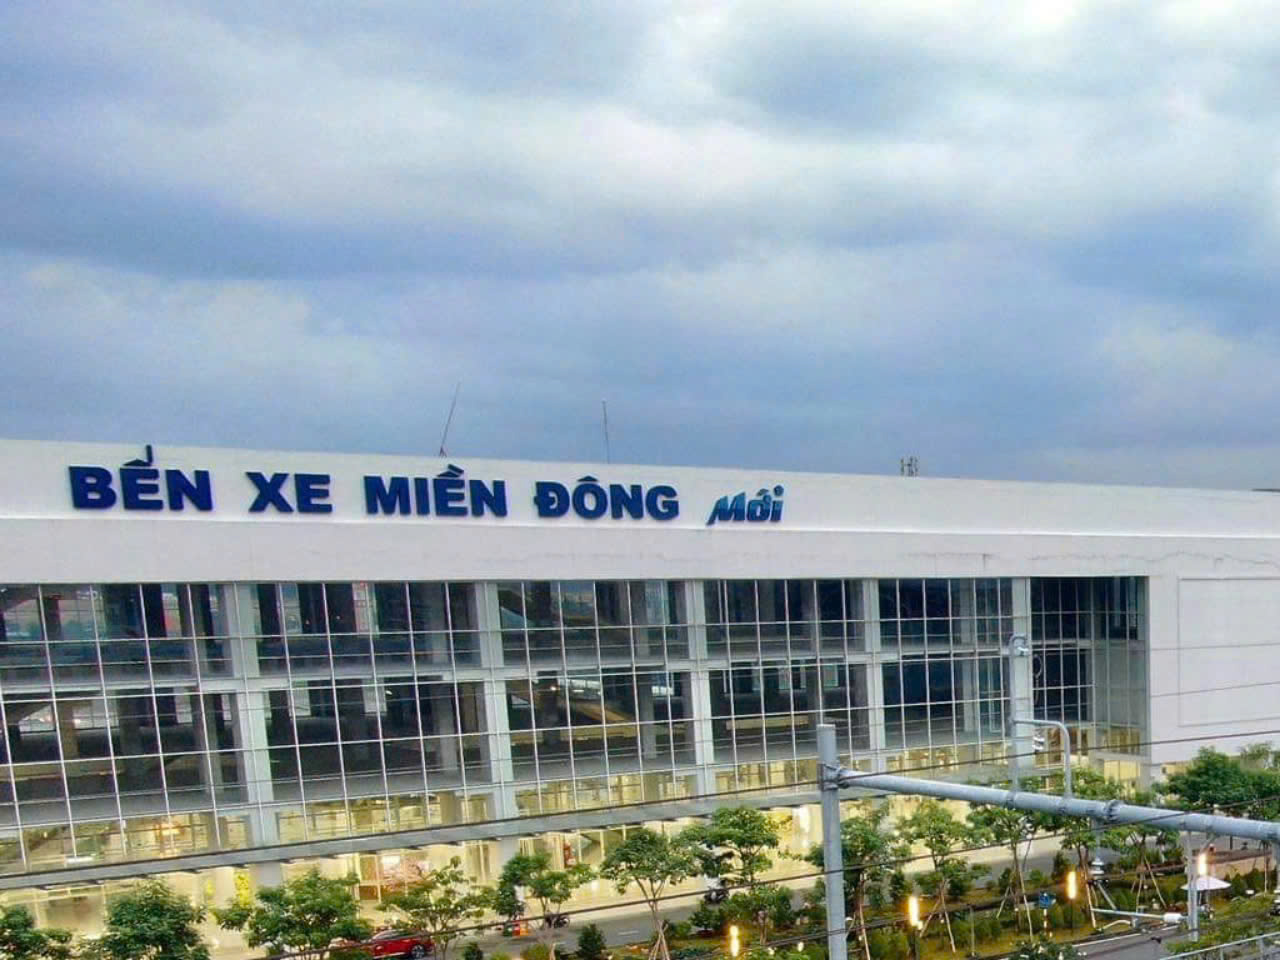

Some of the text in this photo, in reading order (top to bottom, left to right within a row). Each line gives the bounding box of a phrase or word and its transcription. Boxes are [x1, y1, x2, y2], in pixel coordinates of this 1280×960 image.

[68, 444, 785, 526] BẾN XE MIỀN ĐÔNG Mới
